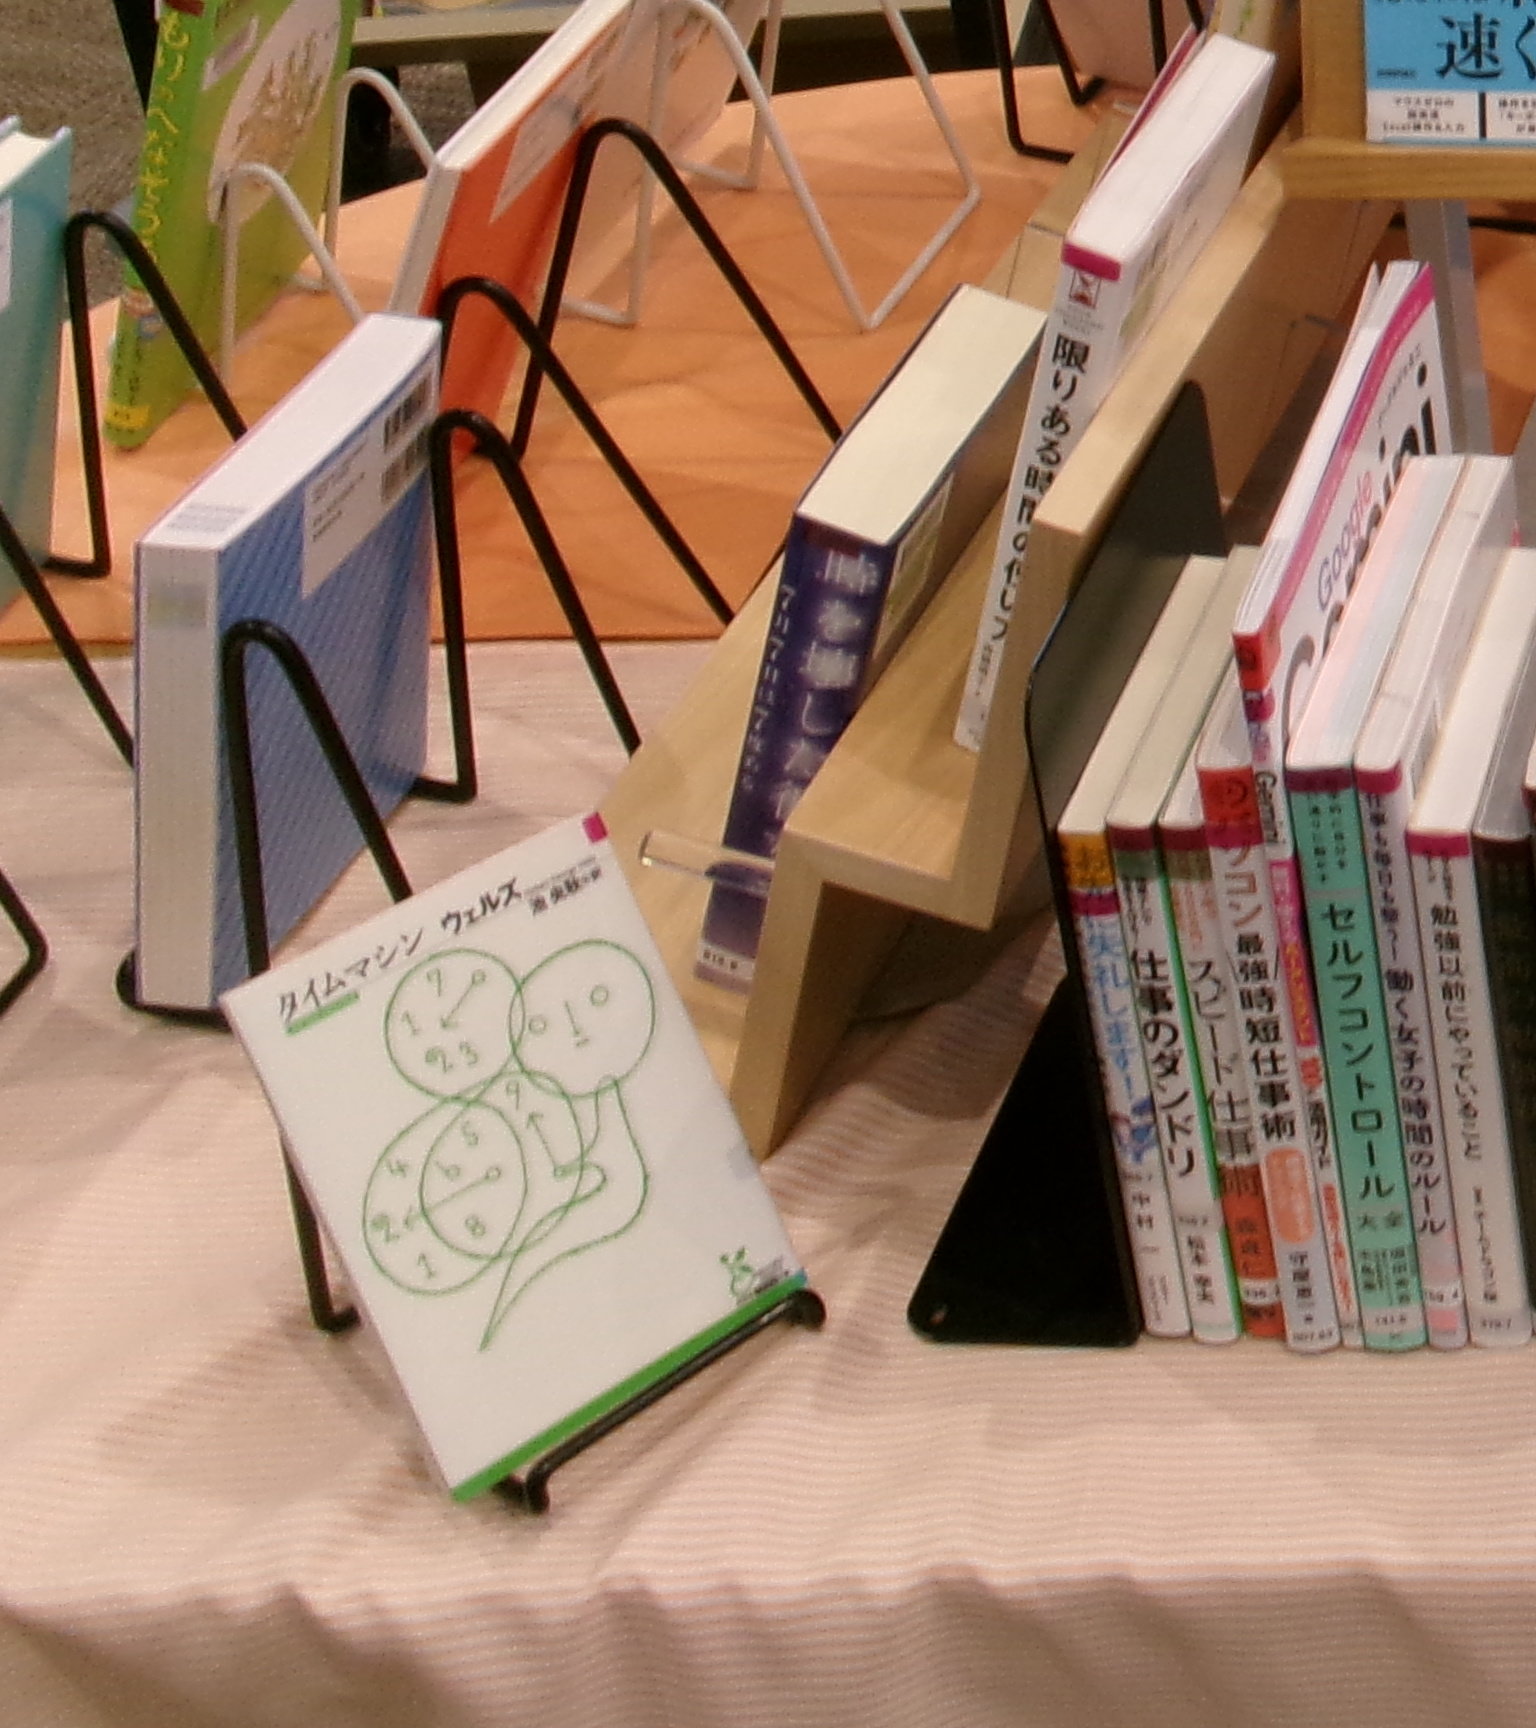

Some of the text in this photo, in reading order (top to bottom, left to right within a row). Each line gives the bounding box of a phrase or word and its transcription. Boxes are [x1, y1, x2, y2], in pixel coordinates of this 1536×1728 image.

[278, 927, 424, 1024] タイムマシン
[1130, 948, 1195, 1177] 仕事のダンドリ
[1320, 903, 1396, 1201] セルフコントロール
